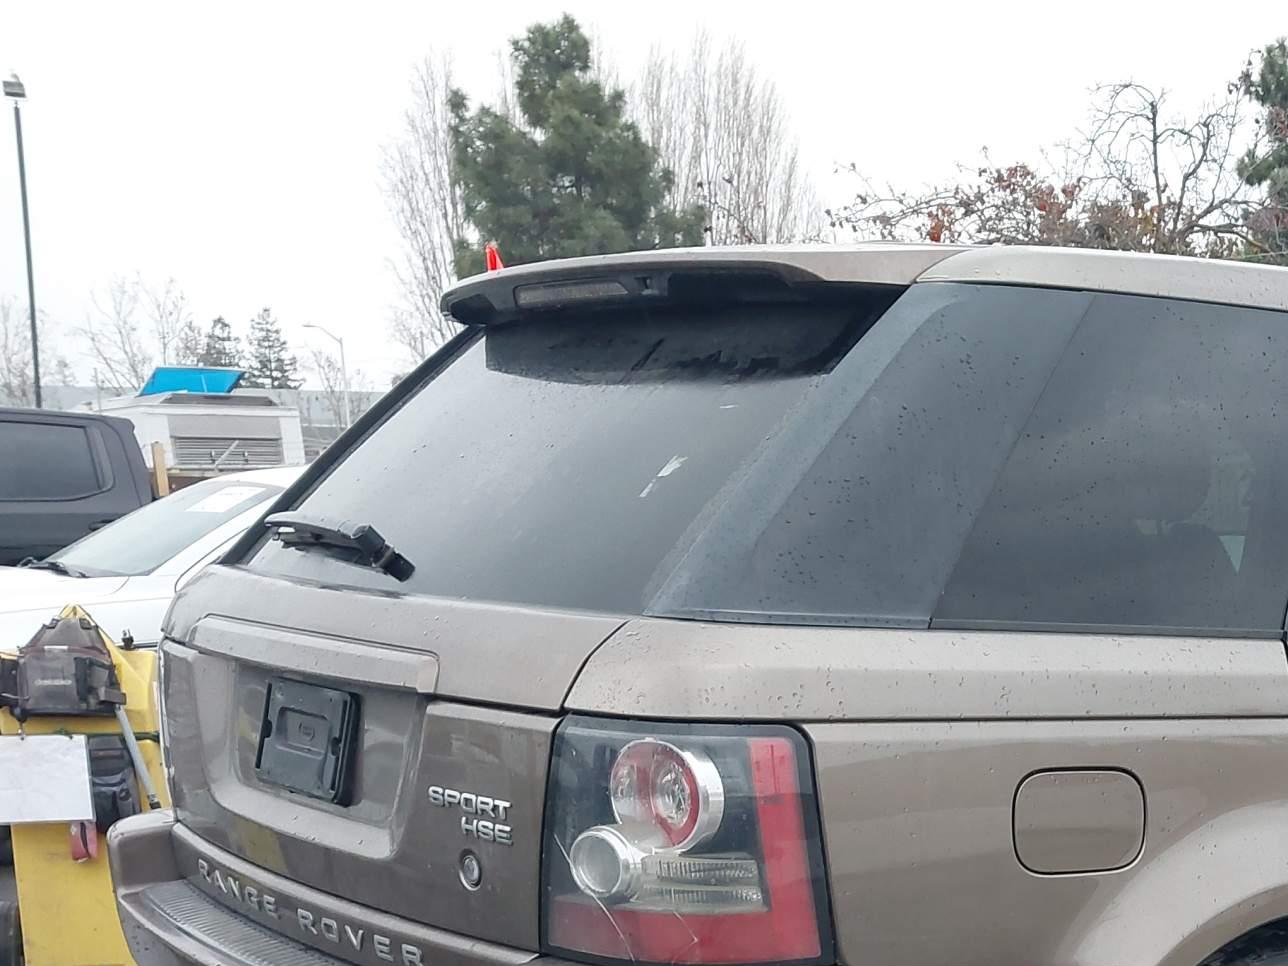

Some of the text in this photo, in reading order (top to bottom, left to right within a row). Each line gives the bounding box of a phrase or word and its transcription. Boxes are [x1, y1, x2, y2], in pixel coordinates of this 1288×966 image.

[428, 785, 512, 820] SPORT
[461, 816, 513, 845] HSE
[198, 858, 279, 918] RANGE
